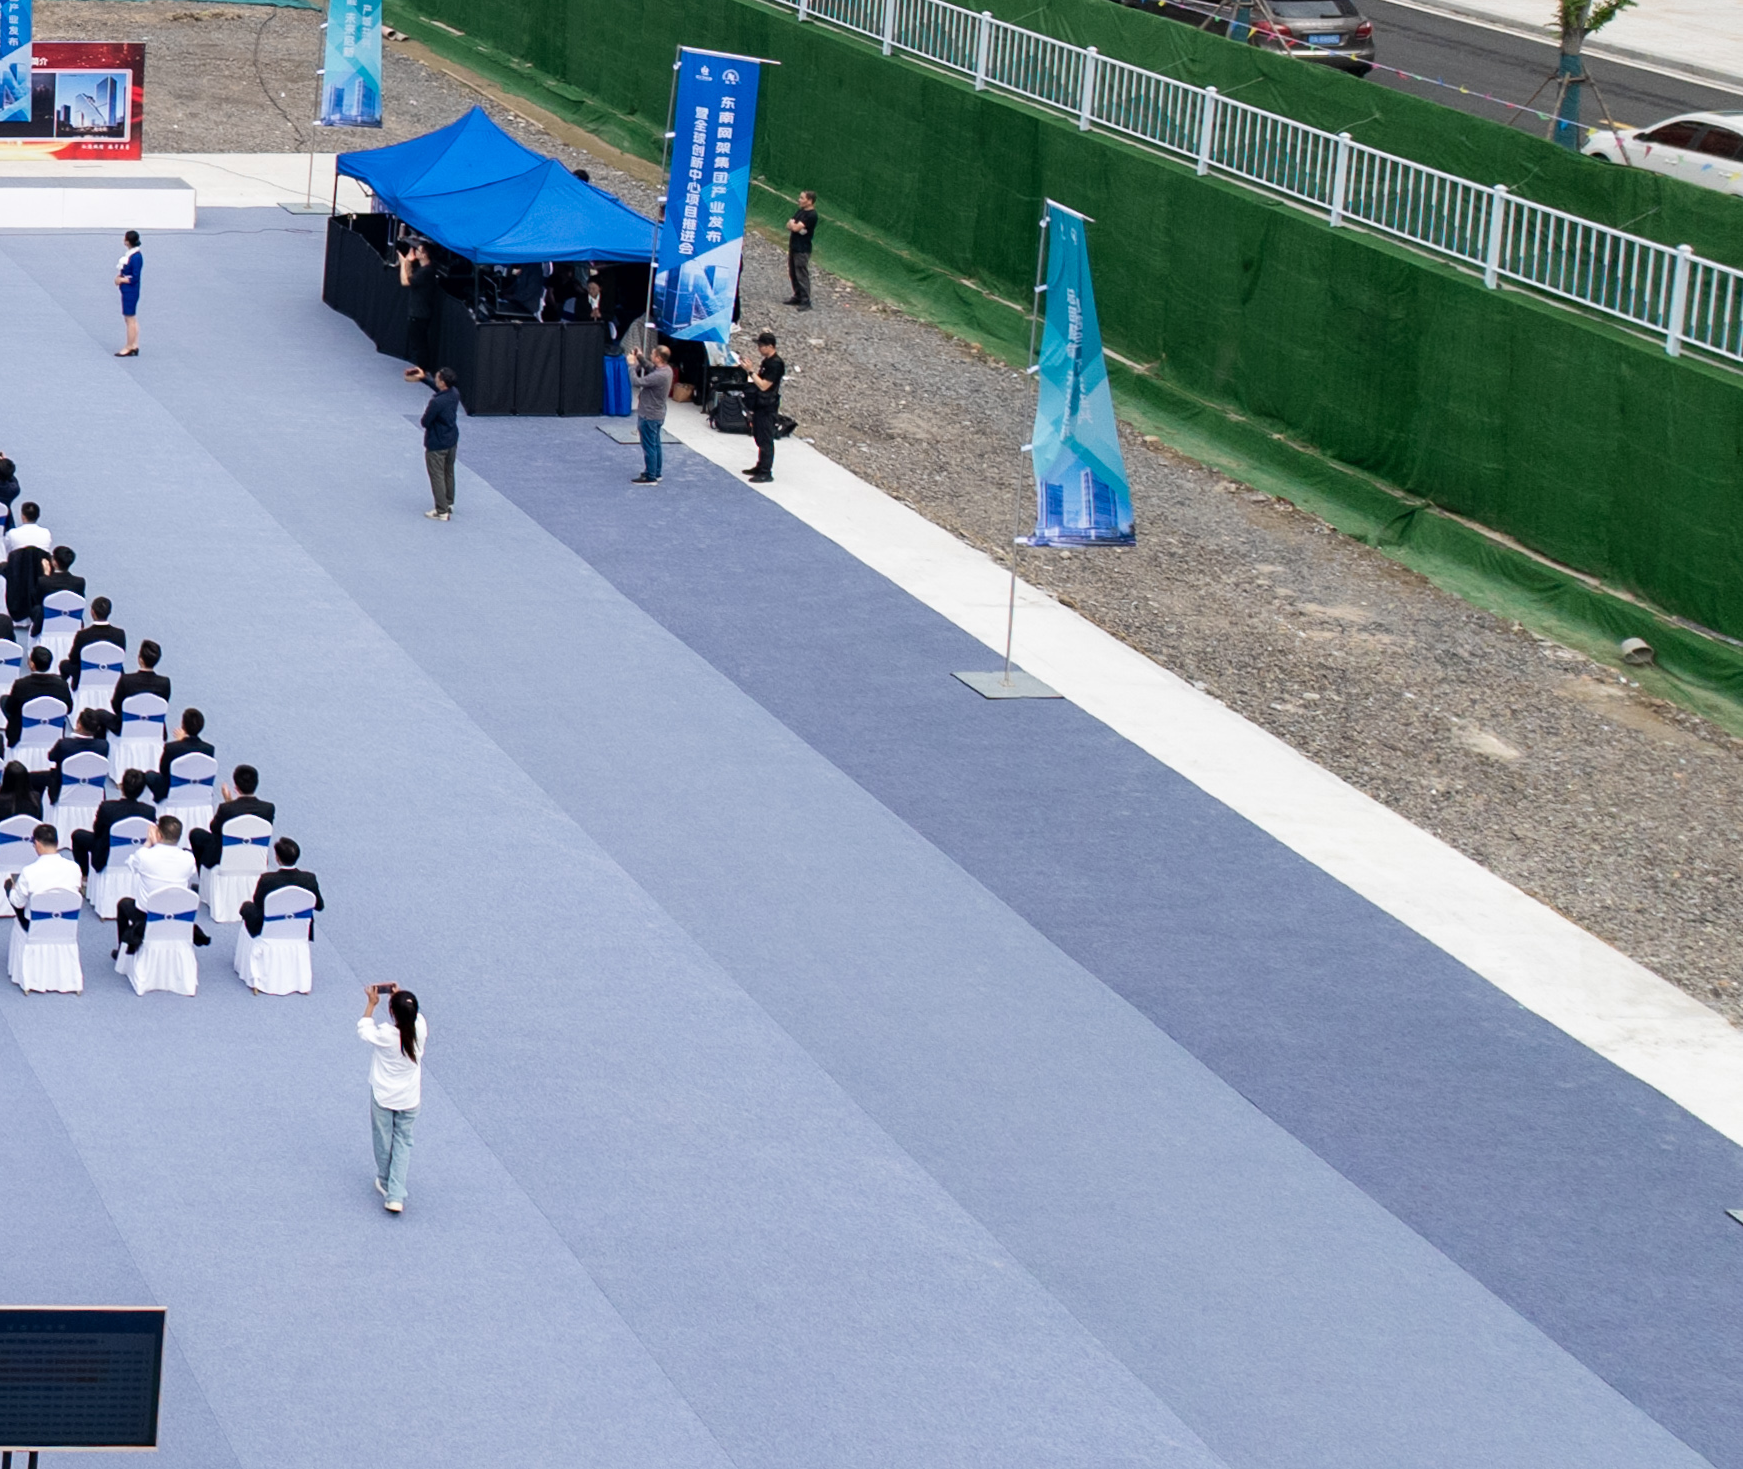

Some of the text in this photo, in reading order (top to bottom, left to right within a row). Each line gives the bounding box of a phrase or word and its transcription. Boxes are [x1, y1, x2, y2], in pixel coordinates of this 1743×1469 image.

[678, 106, 709, 255] 暨全球创新中心项目推进会
[706, 96, 736, 243] 东南网架集团产业发布
